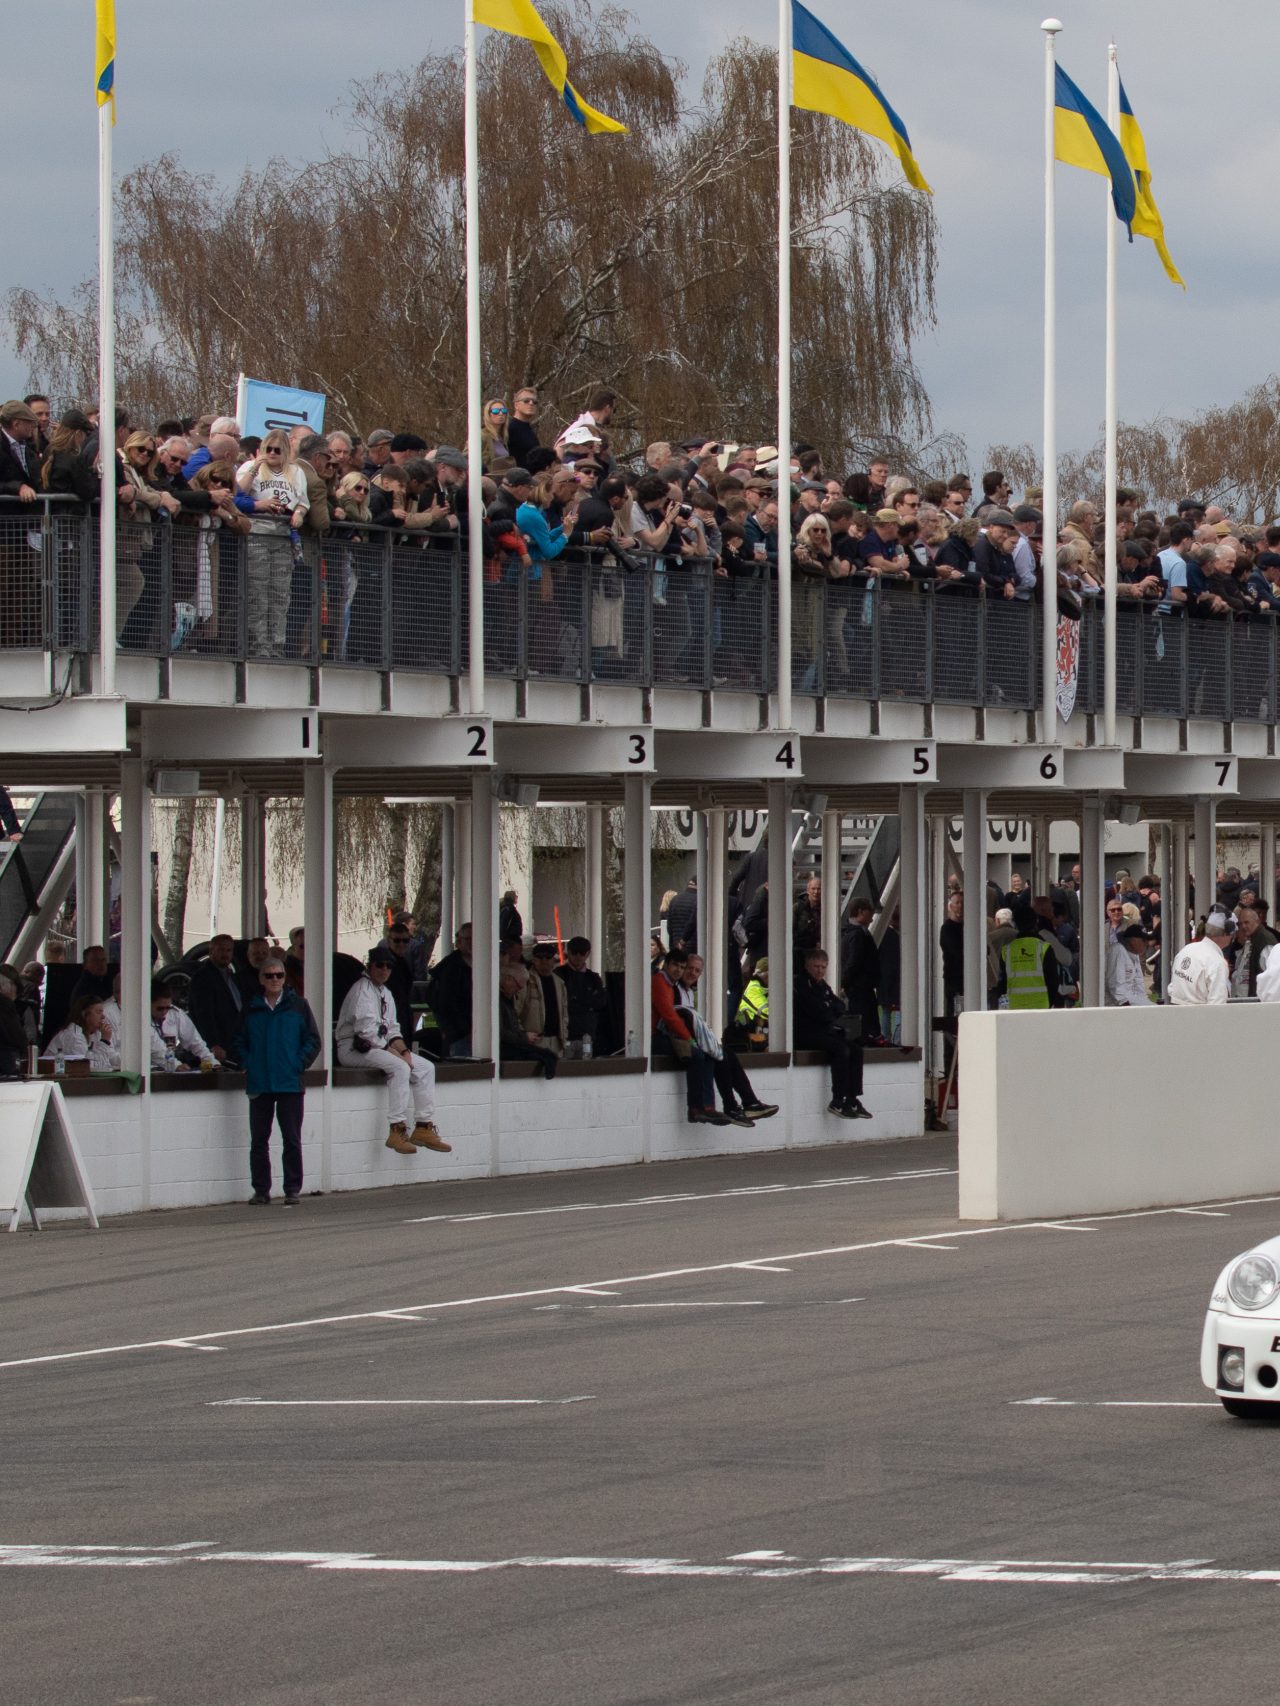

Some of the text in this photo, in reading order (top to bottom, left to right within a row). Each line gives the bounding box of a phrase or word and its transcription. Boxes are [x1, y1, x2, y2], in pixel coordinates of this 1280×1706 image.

[301, 716, 309, 748] 1
[467, 725, 486, 757] 2
[628, 735, 646, 764] 3
[775, 741, 795, 770] 4
[913, 746, 929, 775] 5
[1040, 752, 1057, 780] 6
[1215, 761, 1231, 787] 7
